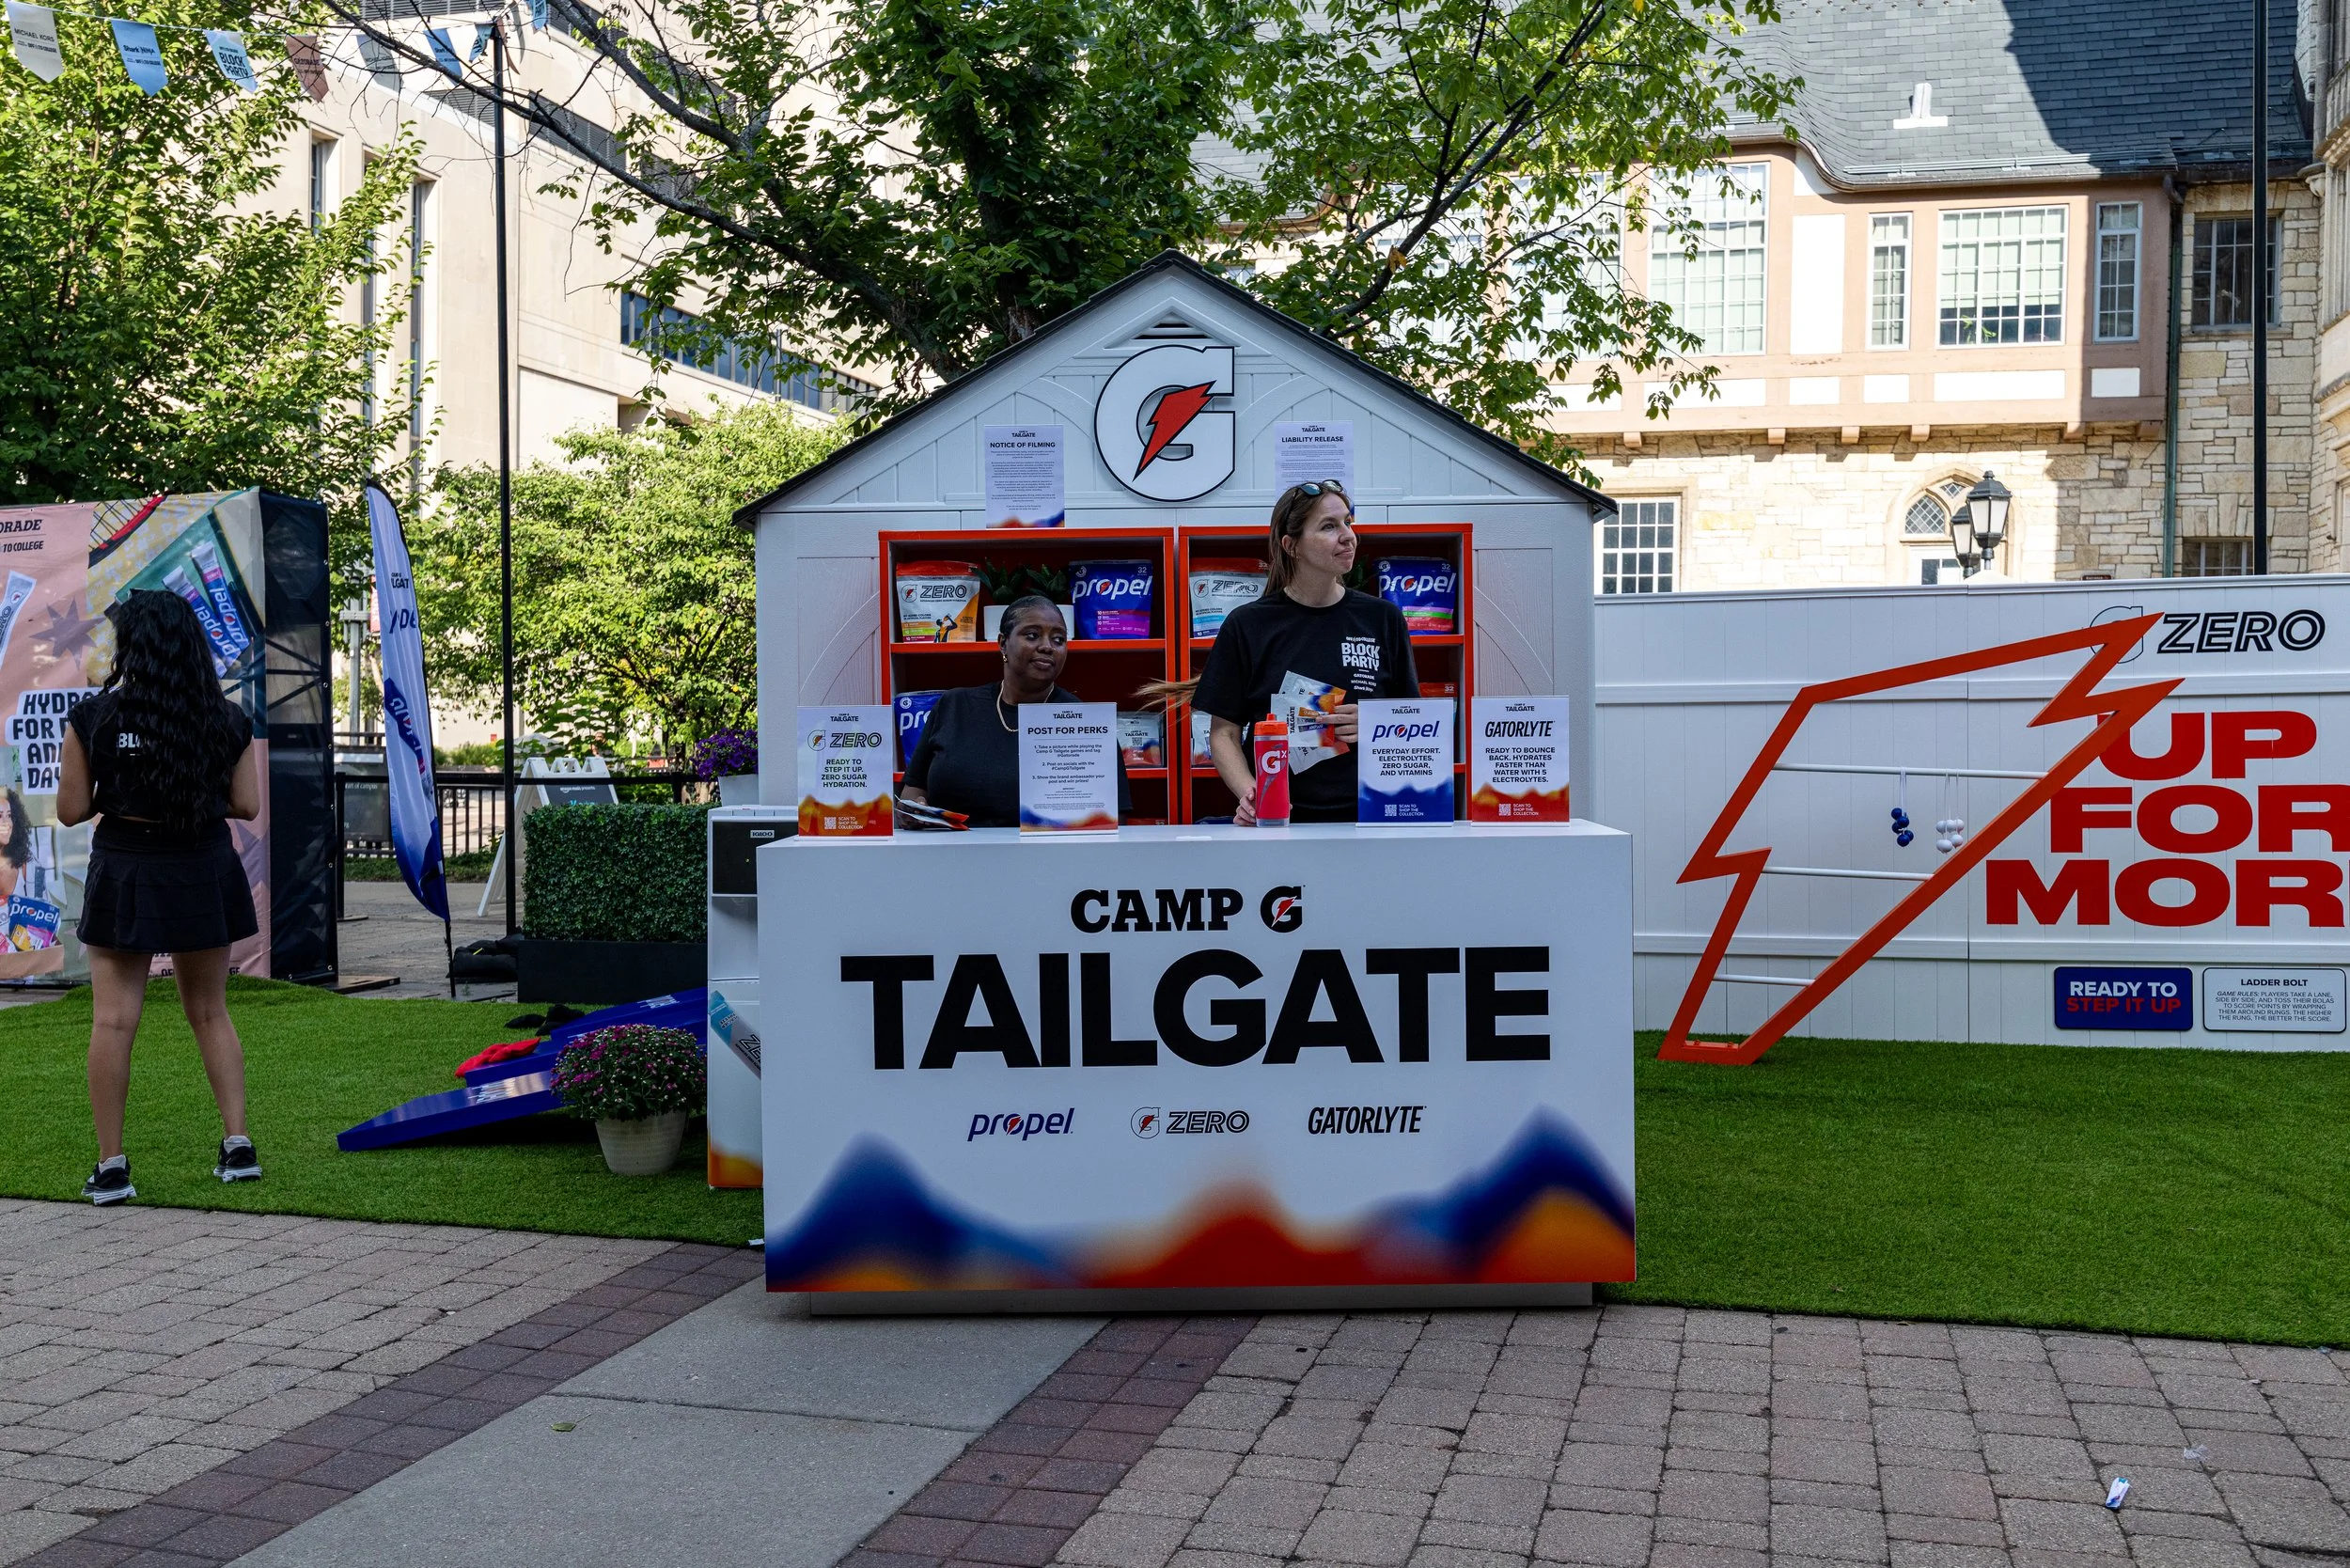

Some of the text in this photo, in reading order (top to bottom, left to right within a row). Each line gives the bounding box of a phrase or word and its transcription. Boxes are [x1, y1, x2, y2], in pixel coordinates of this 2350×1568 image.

[14, 27, 55, 42] MICHAEL KORS
[219, 52, 243, 67] BLOCK
[223, 64, 249, 77] PARTY
[1094, 344, 1235, 502] G
[3, 541, 44, 553] TO COLLEGE
[920, 585, 967, 598] ZERO
[1073, 575, 1152, 604] propel
[1212, 580, 1258, 593] ZERO
[1379, 573, 1456, 598] propel
[209, 587, 249, 643] propel
[194, 605, 241, 656] propel
[2157, 609, 2326, 653] ZERO
[1341, 643, 1380, 659] BLOCK
[1342, 655, 1380, 671] PARTY
[12, 718, 55, 740] FOR
[830, 731, 883, 748] ZERO
[1372, 721, 1440, 742] propel
[1485, 721, 1553, 737] GATORLYTE
[2097, 711, 2317, 781] UP
[2050, 784, 2350, 854] FOR
[1985, 858, 2350, 927] MOR
[10, 902, 59, 924] propel
[1070, 886, 1303, 934] CAMP G
[2070, 981, 2177, 997] READY TO
[840, 946, 1551, 1070] TAILGATE
[2067, 997, 2181, 1013] STEP IT UP
[966, 1107, 1073, 1141] propel
[1167, 1109, 1250, 1134] ZERO
[1308, 1105, 1425, 1136] GATORLYTE
